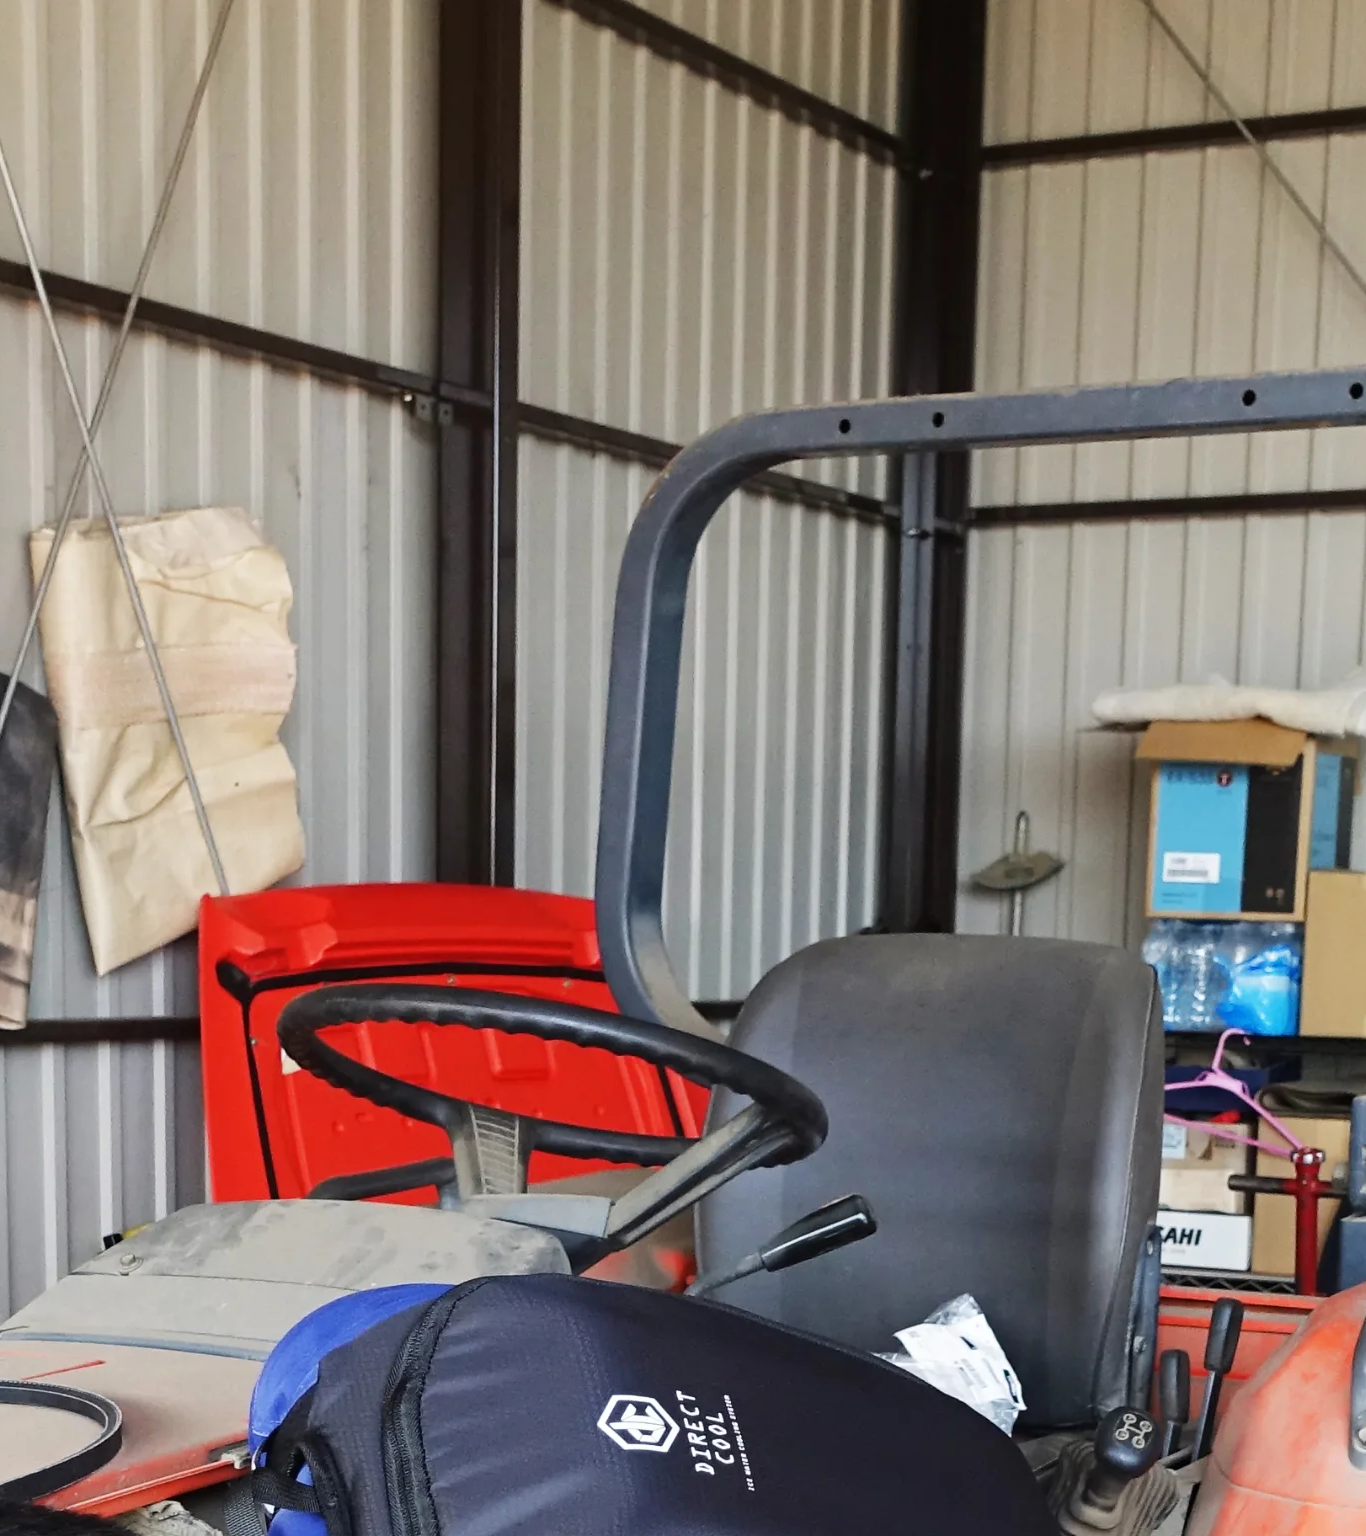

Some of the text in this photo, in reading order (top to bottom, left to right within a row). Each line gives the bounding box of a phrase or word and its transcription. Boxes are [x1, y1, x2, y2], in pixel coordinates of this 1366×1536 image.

[675, 1389, 715, 1476] DIRECT
[705, 1412, 735, 1465] COOL
[740, 1452, 752, 1476] WATER
[746, 1477, 756, 1492] ICE
